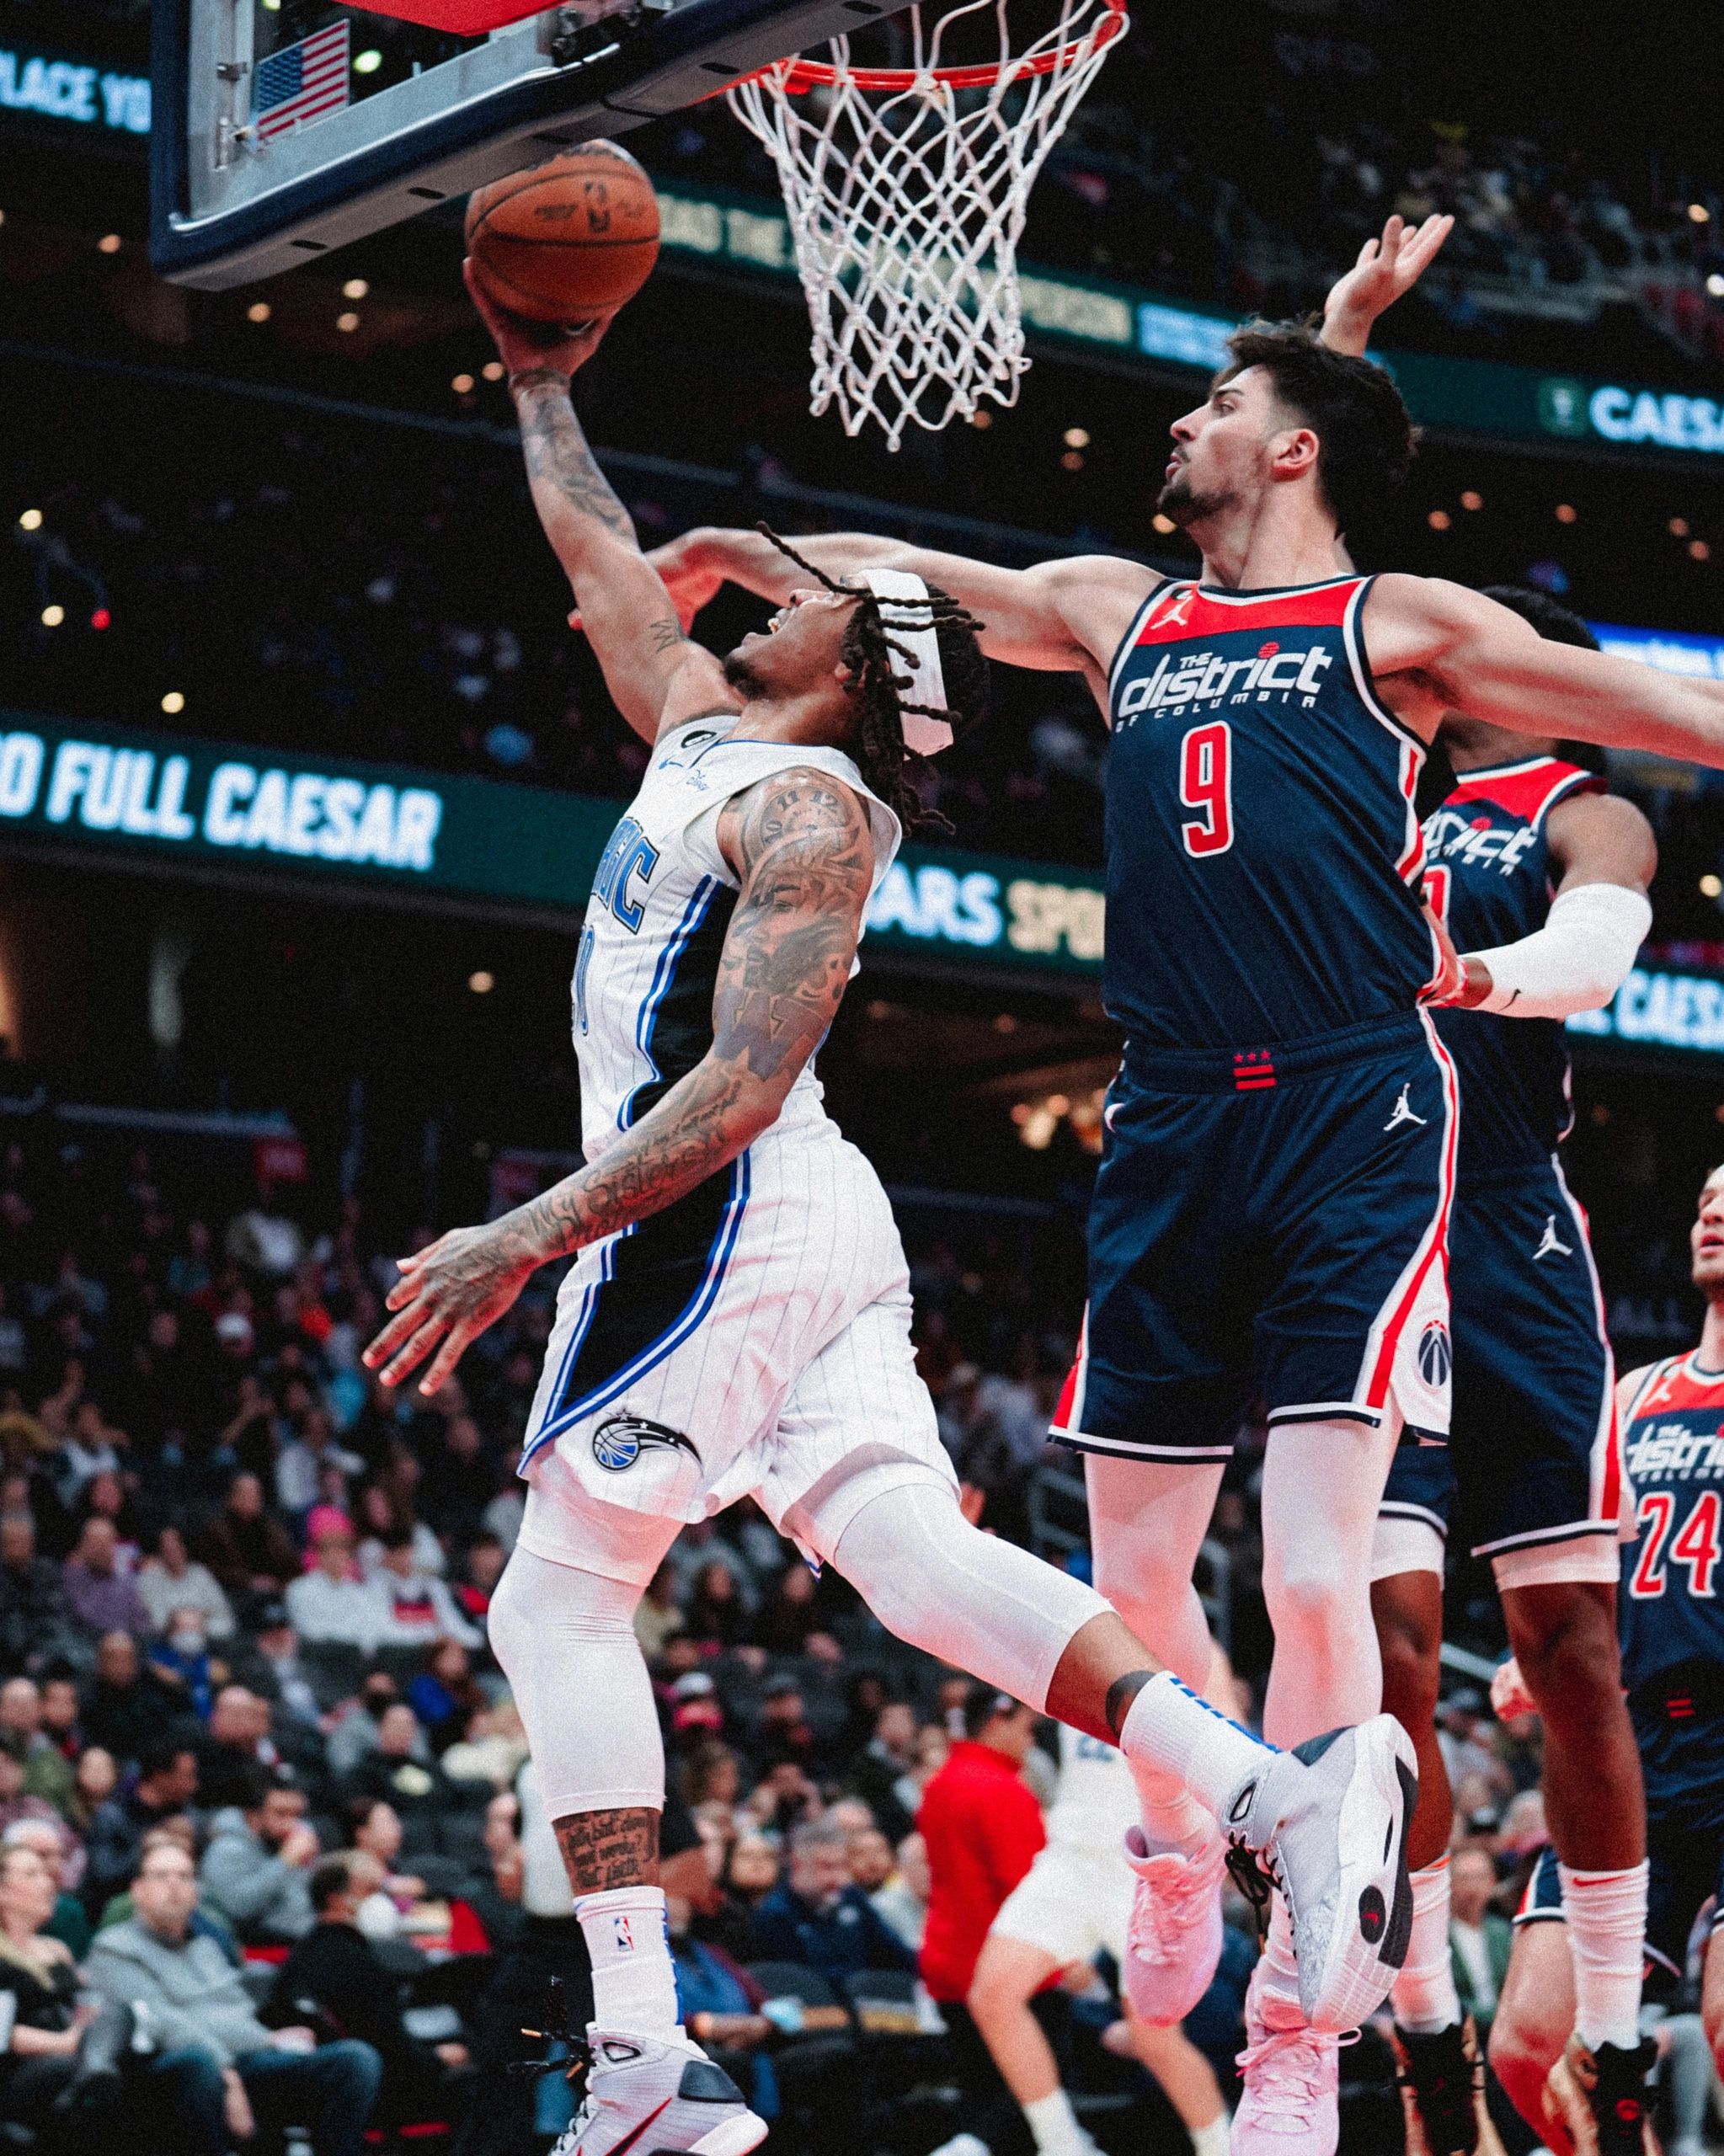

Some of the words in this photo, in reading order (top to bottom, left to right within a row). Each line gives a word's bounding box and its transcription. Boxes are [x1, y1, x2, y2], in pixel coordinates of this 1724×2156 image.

[0, 49, 99, 121] LACE
[1589, 386, 1724, 455] CAES
[1118, 644, 1332, 718] district
[1179, 652, 1213, 670] THE
[1154, 690, 1316, 719] COLUMBIA
[0, 730, 45, 818] O
[45, 739, 196, 842] FULL
[202, 762, 444, 873] CAESAR
[1180, 720, 1235, 859] 9
[1629, 1490, 1722, 1599] 24
